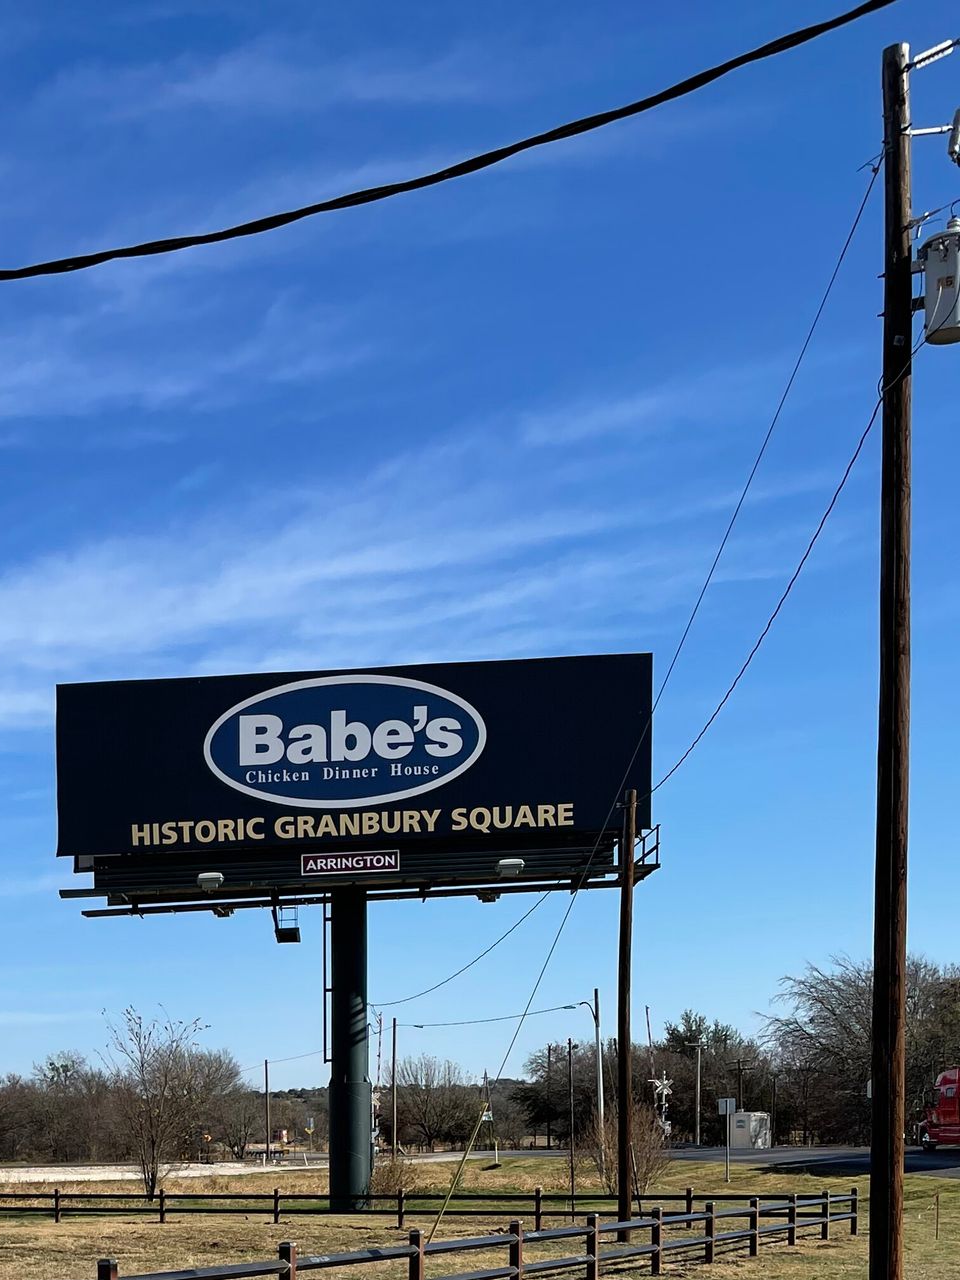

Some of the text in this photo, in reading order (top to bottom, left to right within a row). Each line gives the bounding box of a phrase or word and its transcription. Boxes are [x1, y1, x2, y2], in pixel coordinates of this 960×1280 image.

[239, 705, 463, 766] Babe's
[245, 763, 439, 783] Chicken Dinner House
[131, 803, 575, 846] HISTORIC GRANBURY SQUARE
[305, 855, 396, 870] ARRINGTON
